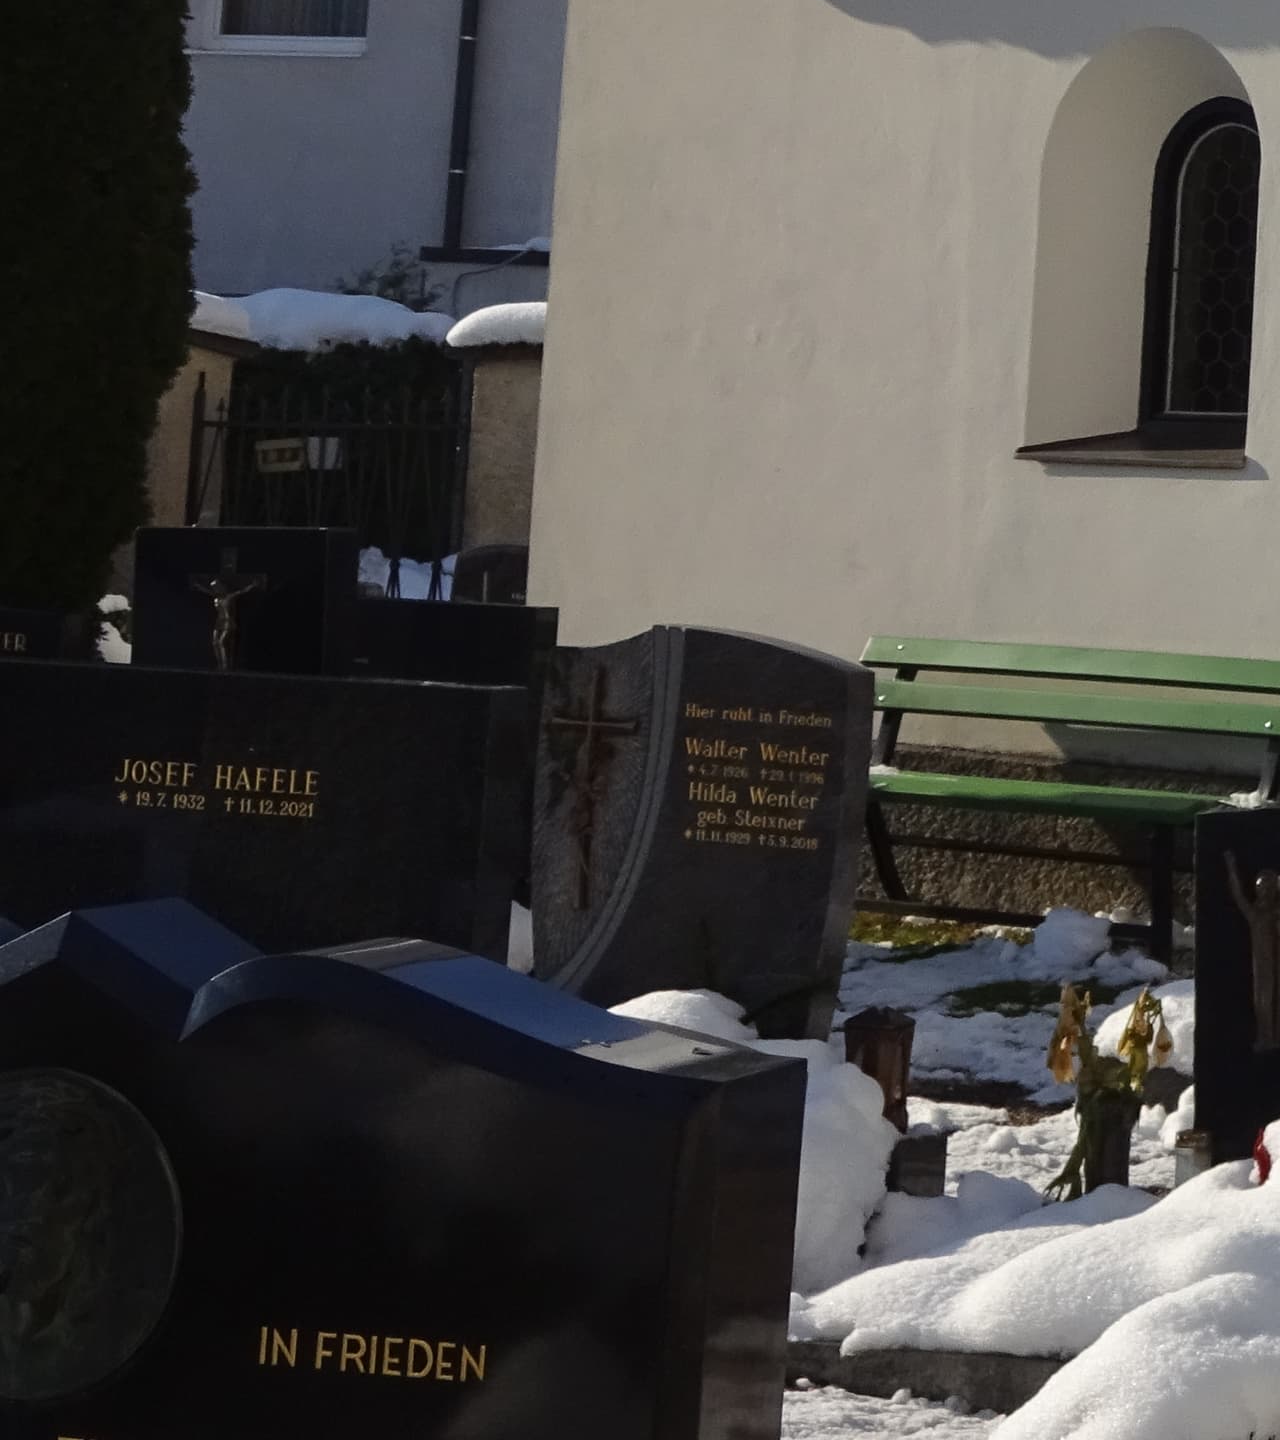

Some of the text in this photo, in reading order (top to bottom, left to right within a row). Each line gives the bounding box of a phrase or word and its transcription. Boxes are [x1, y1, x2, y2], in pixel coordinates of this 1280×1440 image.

[0, 632, 27, 652] ER
[685, 703, 716, 719] Hier
[759, 711, 773, 725] in
[779, 710, 833, 729] Frieden
[685, 736, 831, 767] Walter Wenter
[114, 759, 321, 796] JOSEF HAFELE
[688, 781, 820, 810] Hilda Wenter
[734, 809, 807, 832] Steixner
[257, 1326, 488, 1383] IN FRIEDEN
